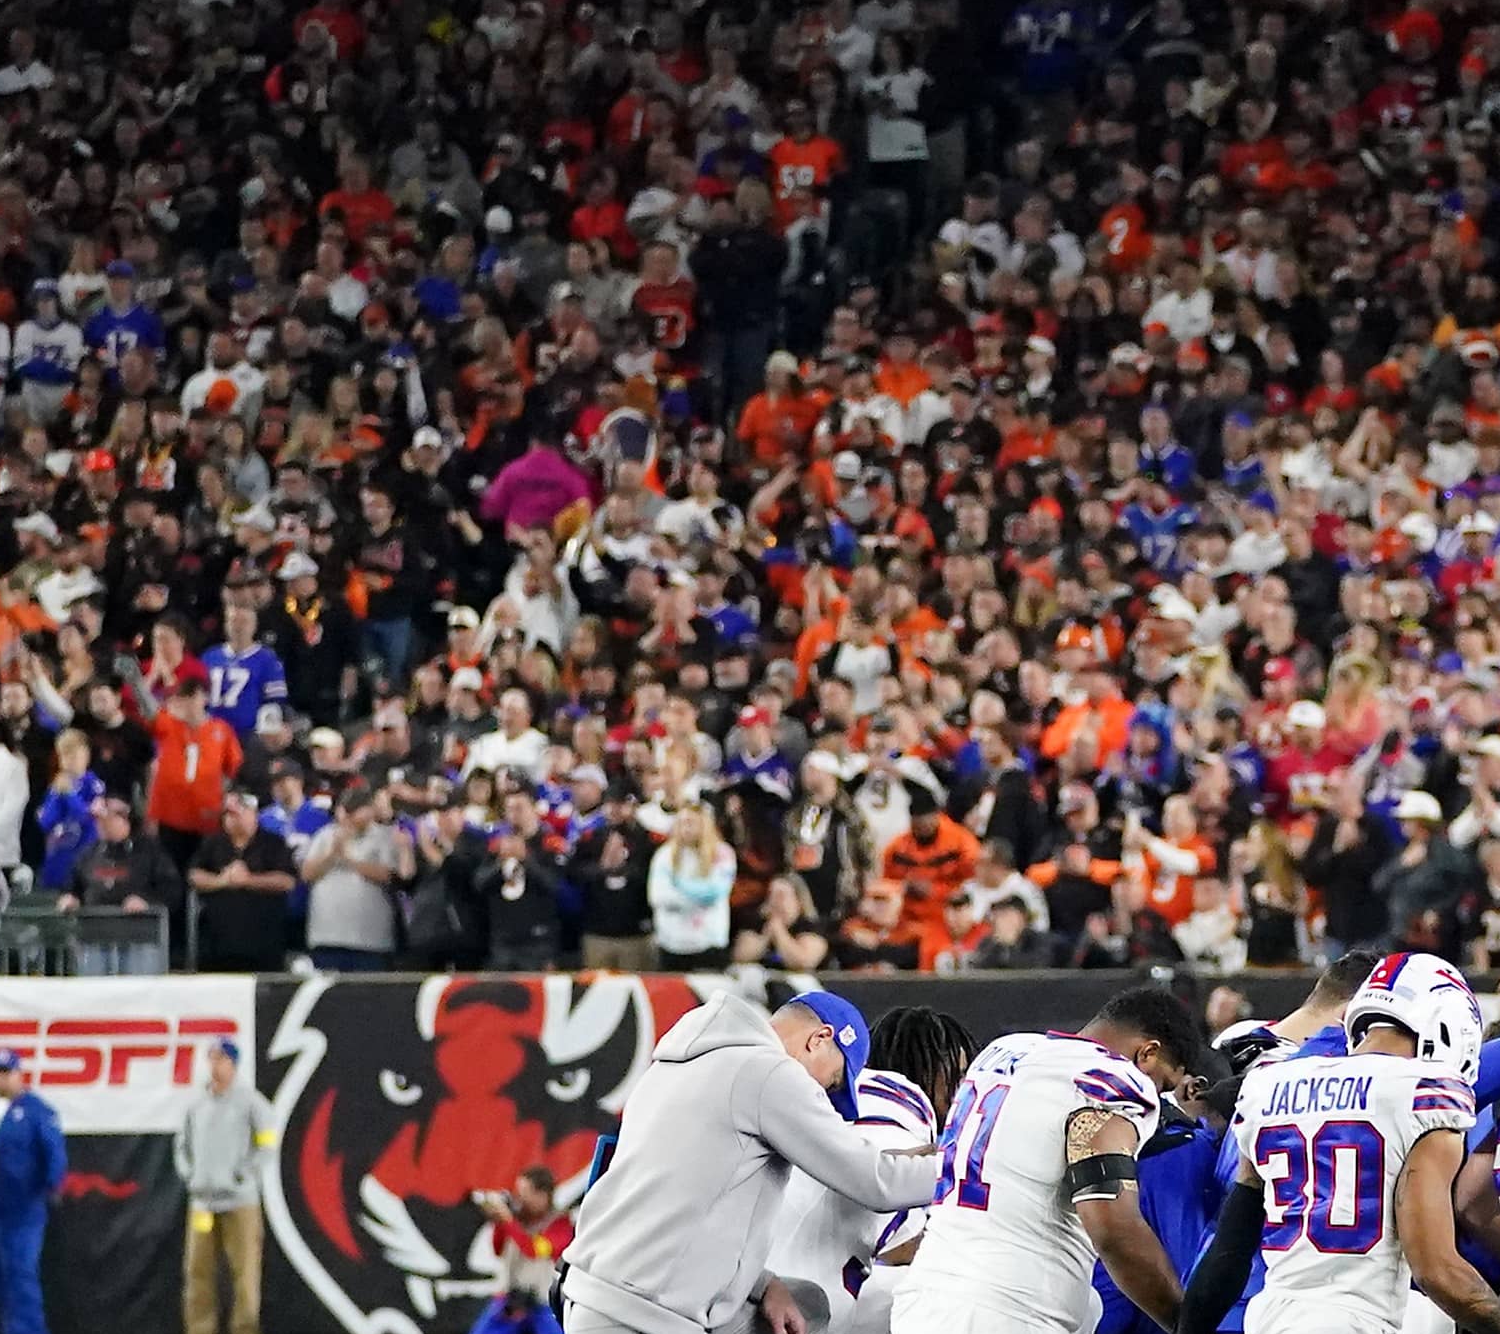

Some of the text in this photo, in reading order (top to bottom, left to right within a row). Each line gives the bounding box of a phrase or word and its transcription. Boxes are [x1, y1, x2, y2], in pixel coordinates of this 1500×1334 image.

[207, 666, 252, 710] 17
[183, 742, 200, 784] 1
[1261, 1075, 1374, 1117] JACKSON
[1254, 1119, 1385, 1255] 30
